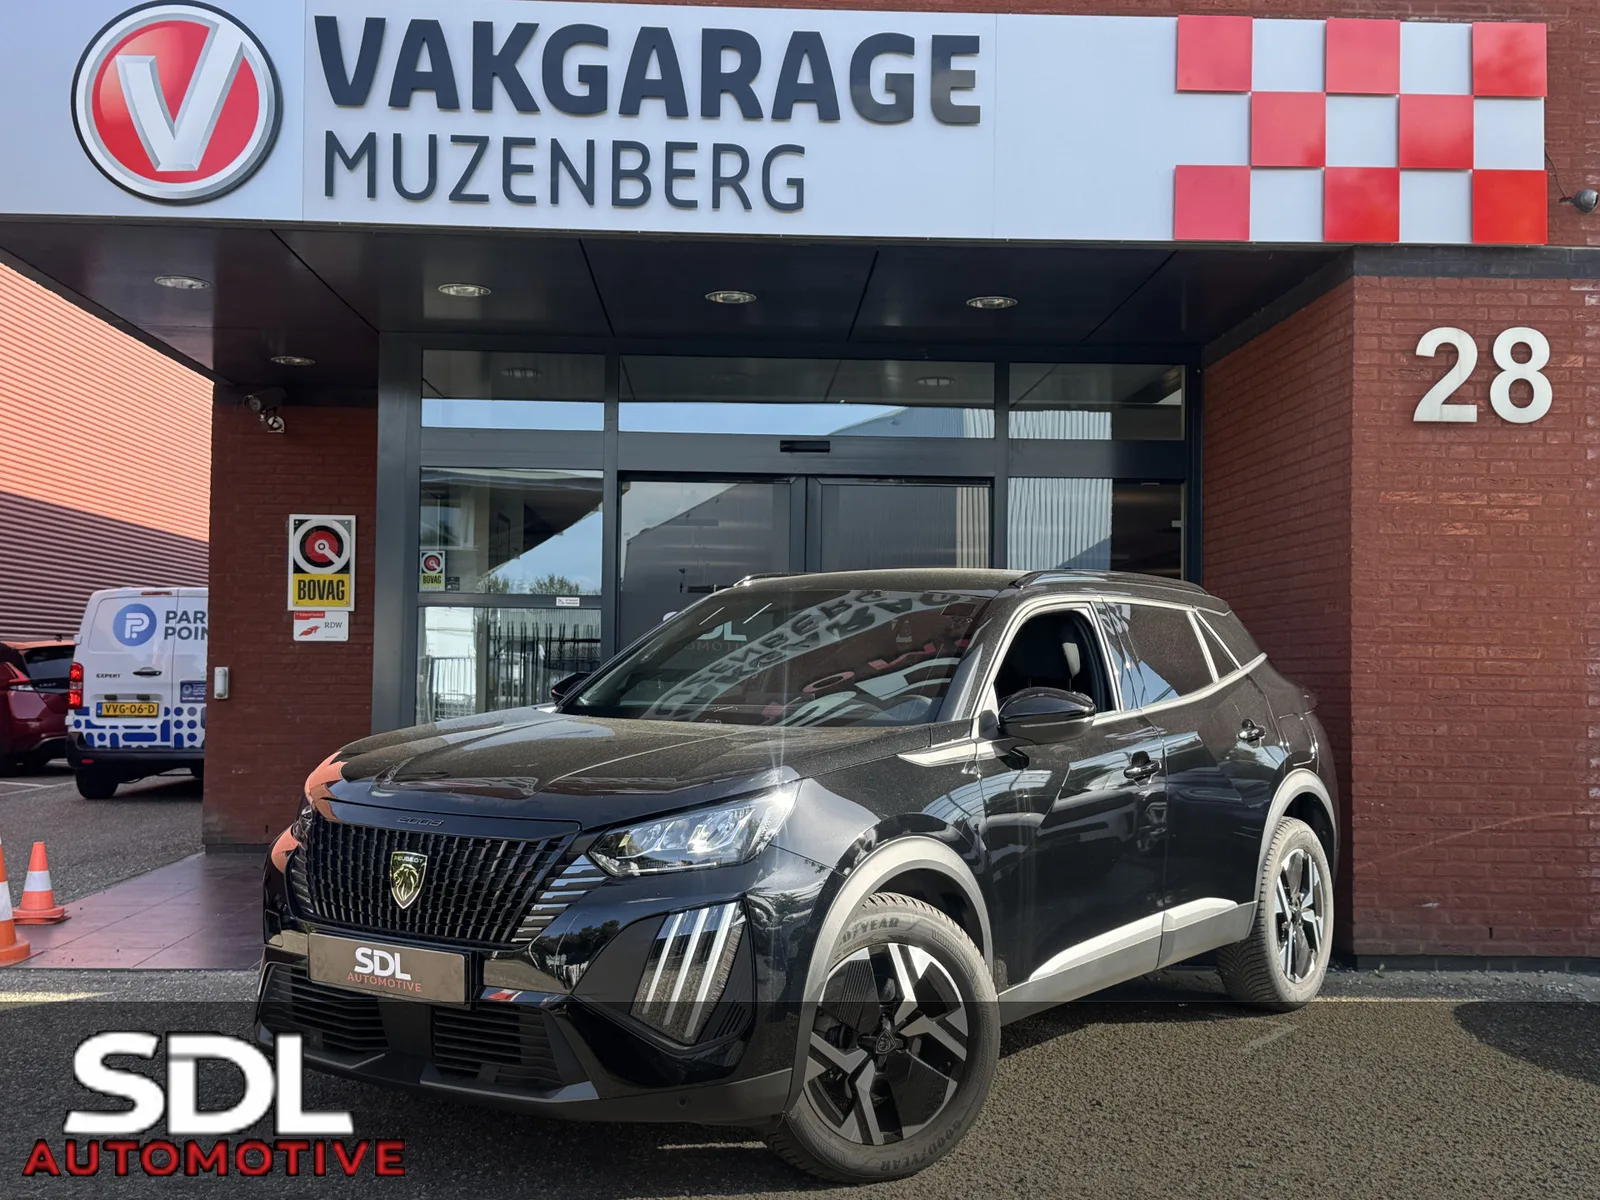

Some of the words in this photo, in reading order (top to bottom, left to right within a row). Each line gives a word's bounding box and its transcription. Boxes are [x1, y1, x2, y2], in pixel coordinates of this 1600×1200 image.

[314, 15, 981, 125] VAKGARAGE
[324, 130, 806, 212] MUZENBERG
[1413, 326, 1553, 424] 28
[422, 575, 442, 584] BOVAG
[297, 579, 345, 601] BOVAG
[165, 610, 206, 624] PAR
[324, 621, 343, 629] RDW
[104, 704, 156, 714] VVG-06-D
[397, 815, 445, 827] 2008
[393, 855, 424, 864] PEUGEOT
[353, 946, 412, 981] SDL
[347, 972, 422, 992] AUTOMOTIVE
